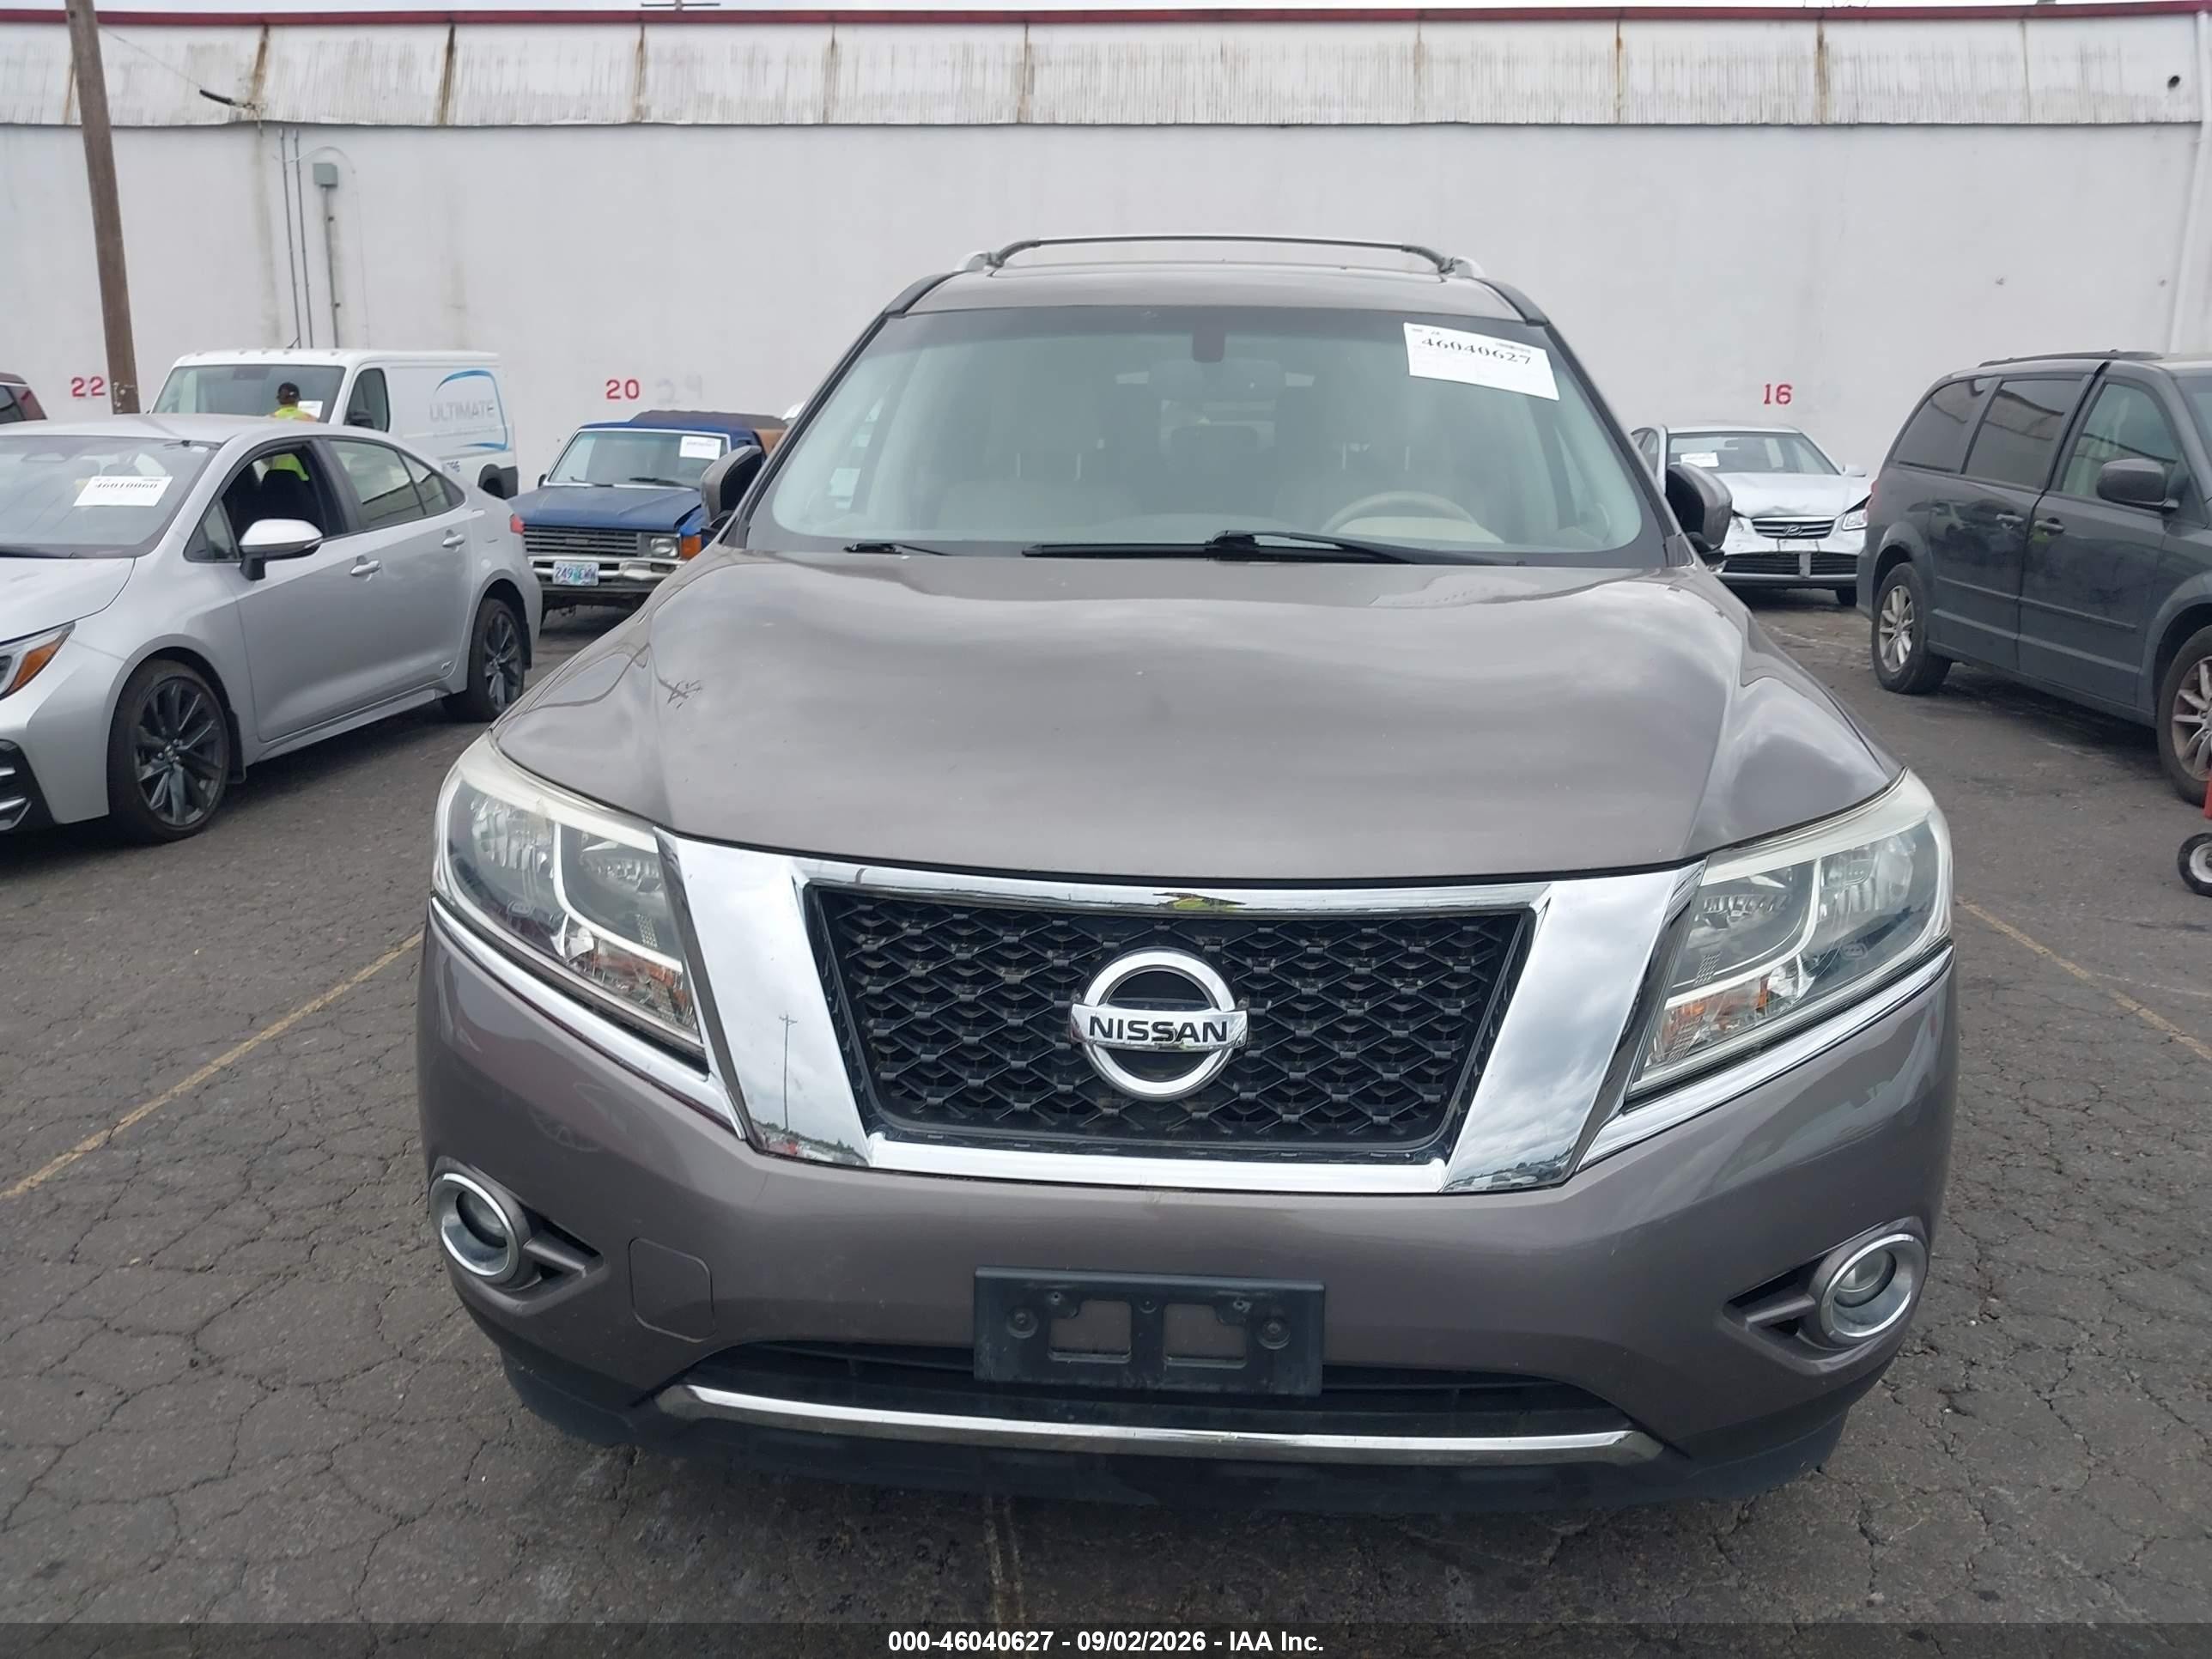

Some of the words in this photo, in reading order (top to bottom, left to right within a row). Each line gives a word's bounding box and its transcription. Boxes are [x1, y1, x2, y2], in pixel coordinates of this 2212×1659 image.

[1421, 337, 1531, 364] 46040627
[71, 376, 106, 397] 22
[605, 379, 640, 399] 20
[1764, 383, 1792, 404] 16
[428, 398, 495, 422] ULTIMATE
[1088, 1016, 1228, 1042] NISSAN
